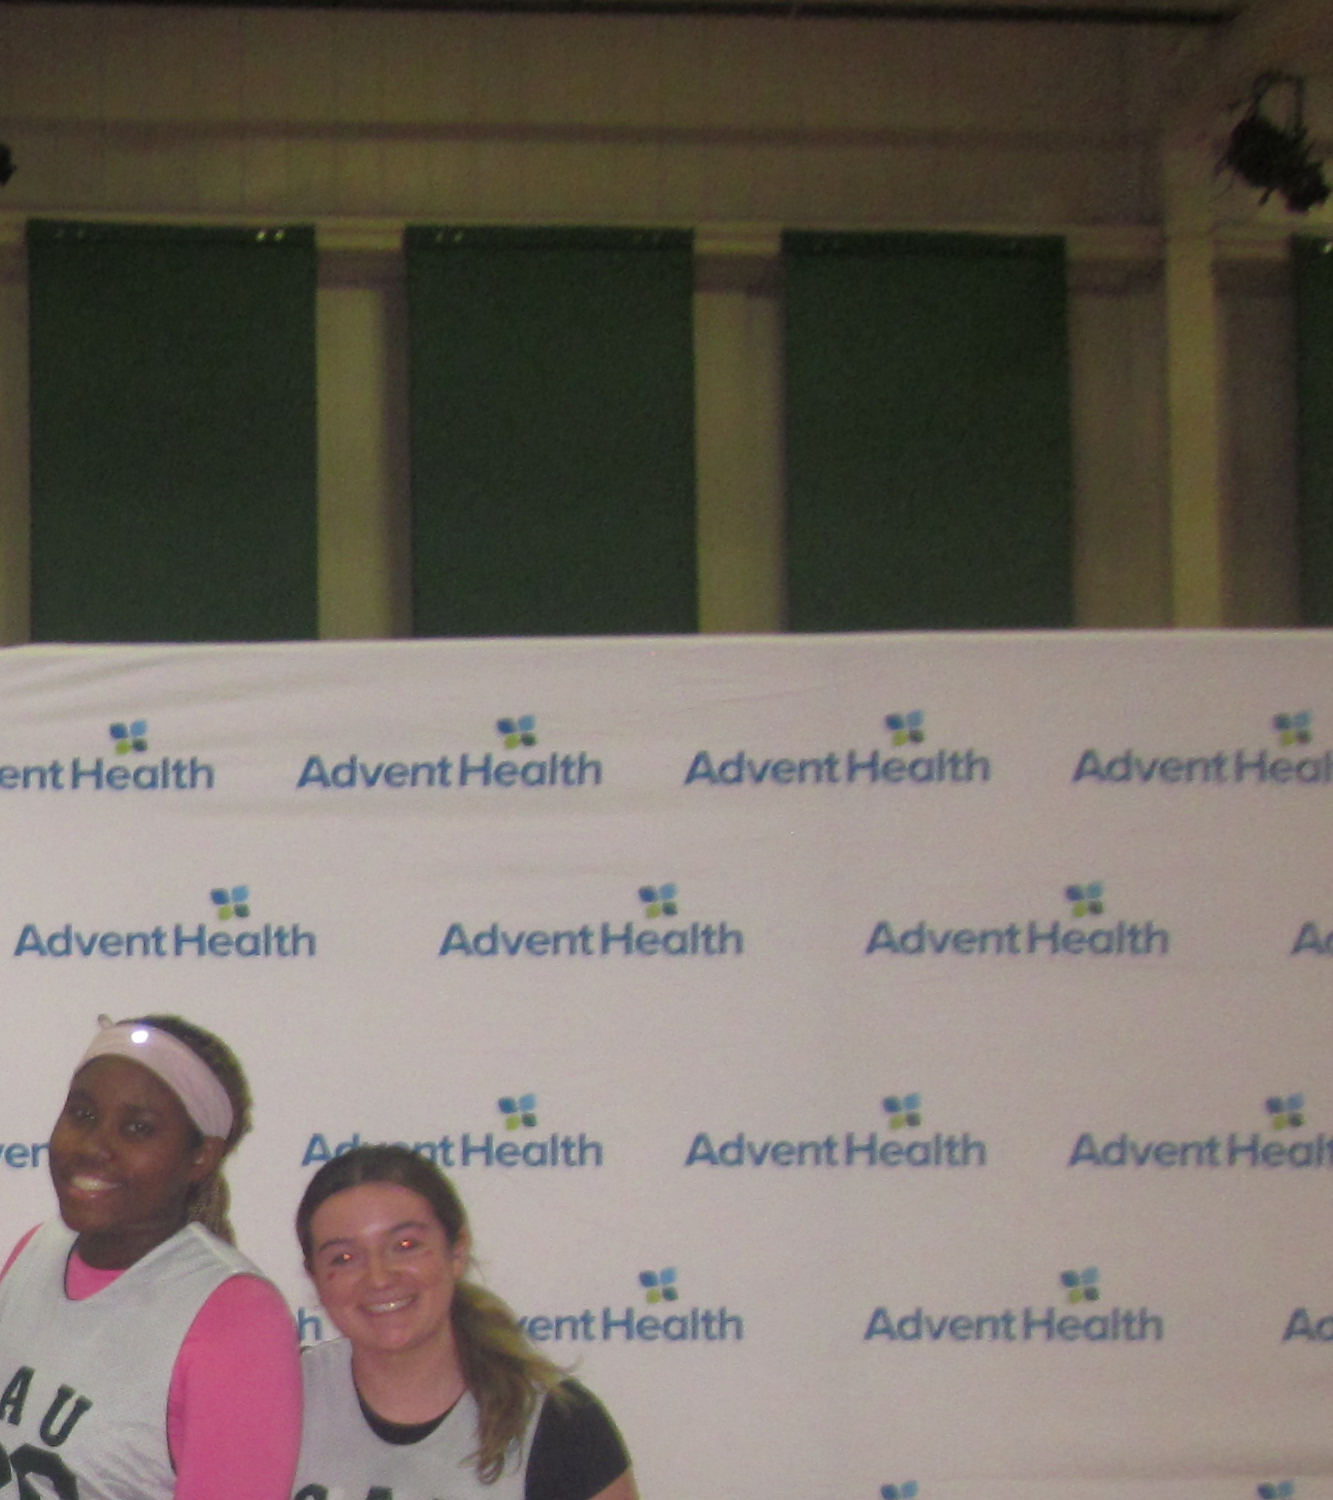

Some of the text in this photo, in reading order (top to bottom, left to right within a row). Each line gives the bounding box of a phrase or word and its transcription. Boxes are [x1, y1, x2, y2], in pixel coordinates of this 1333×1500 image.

[297, 753, 601, 788] AdventHealth
[685, 750, 990, 784] AdventHealth
[14, 923, 316, 957] AdventHealth
[440, 923, 743, 956] AdventHealth
[866, 922, 1169, 955] AdventHealth
[686, 1134, 986, 1166] AdventHealth
[864, 1308, 1163, 1341] AdventHealth
